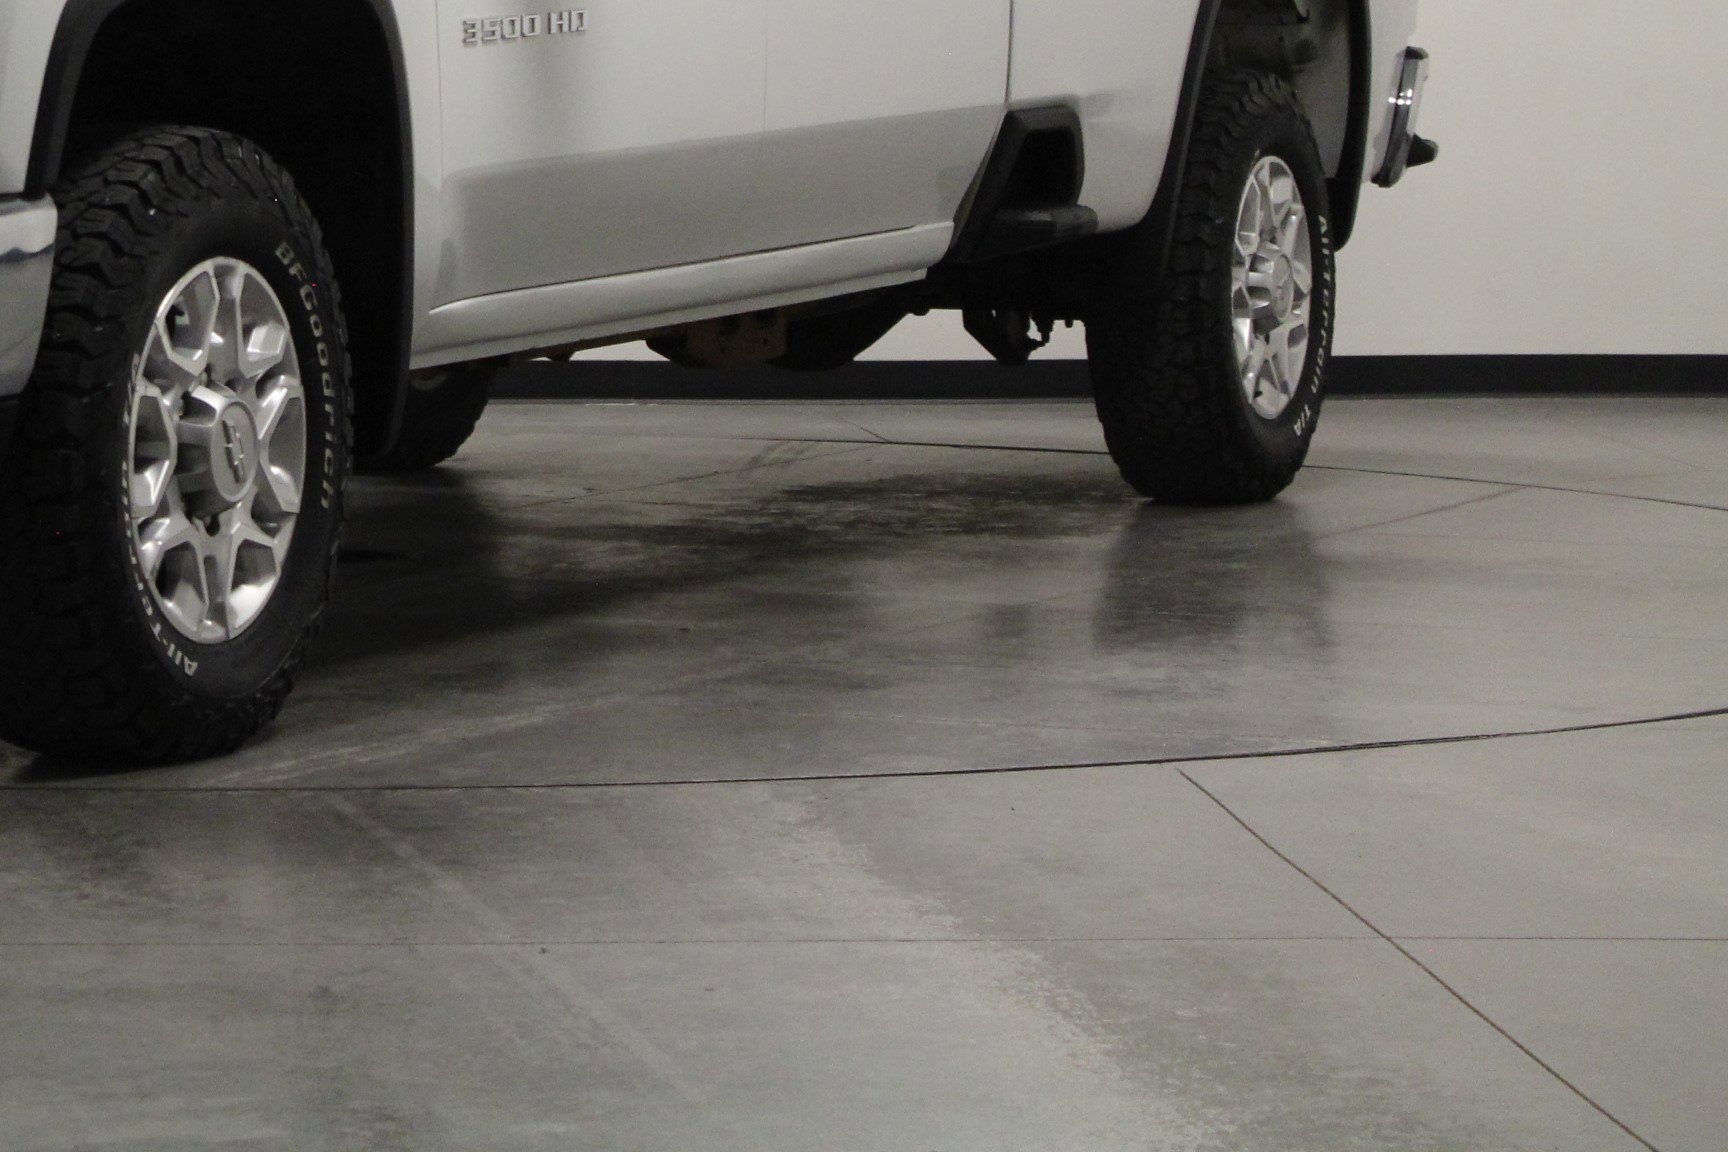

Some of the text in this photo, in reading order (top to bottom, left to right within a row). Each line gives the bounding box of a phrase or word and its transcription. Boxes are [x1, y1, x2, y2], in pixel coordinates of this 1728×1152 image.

[461, 8, 589, 46] 3500 HD
[275, 241, 336, 510] BFGoodrich
